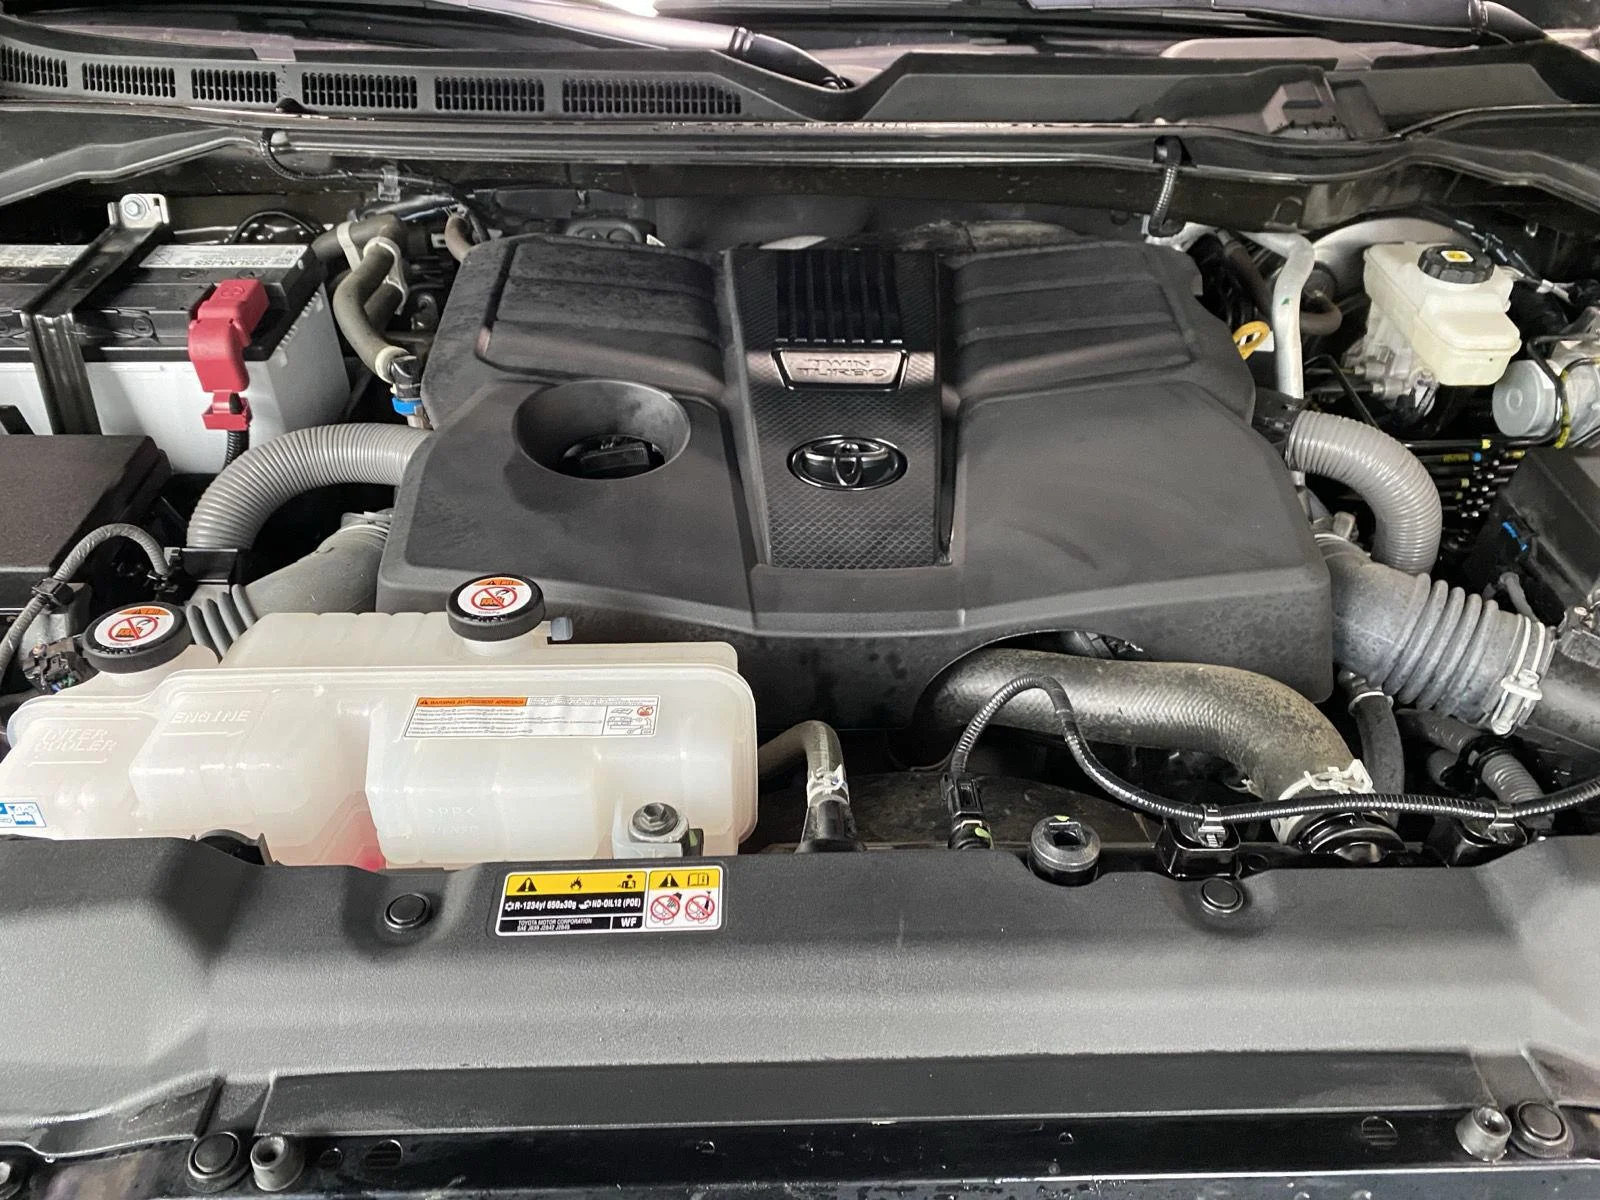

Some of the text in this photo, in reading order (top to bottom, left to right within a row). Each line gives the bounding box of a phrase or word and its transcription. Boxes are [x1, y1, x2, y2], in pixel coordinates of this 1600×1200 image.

[806, 358, 870, 368] TWIN
[797, 367, 886, 377] TURBO
[169, 710, 251, 724] ENGINE
[43, 728, 108, 740] INTER
[34, 739, 118, 752] COOLER
[620, 916, 637, 928] WF
